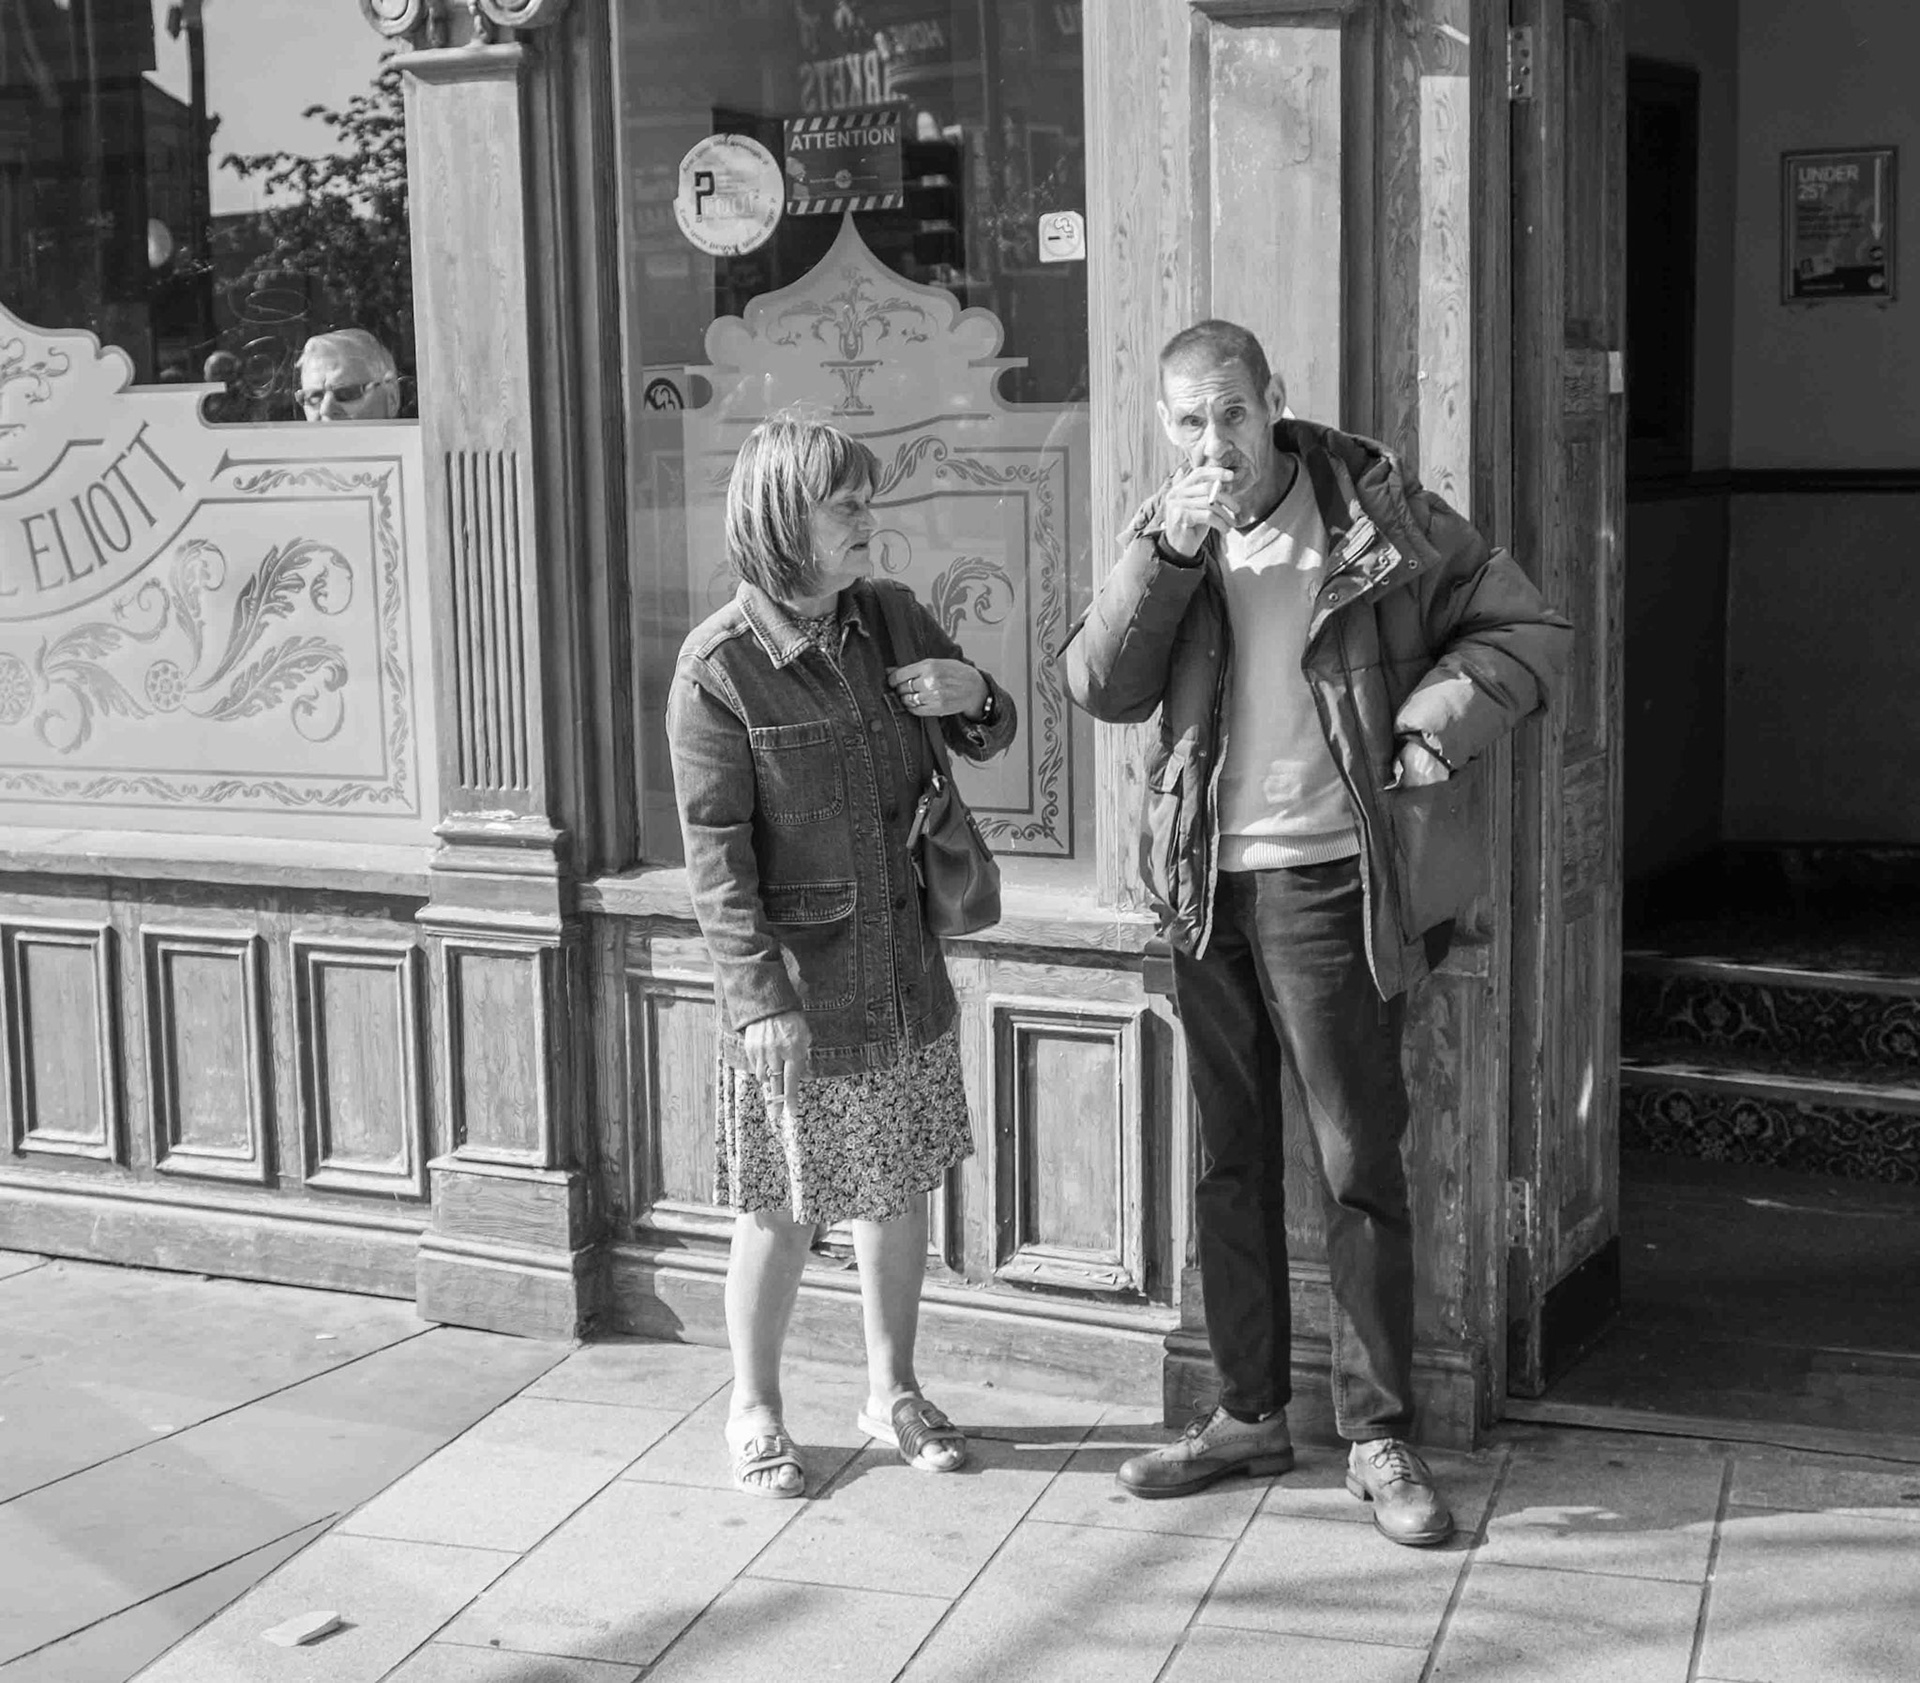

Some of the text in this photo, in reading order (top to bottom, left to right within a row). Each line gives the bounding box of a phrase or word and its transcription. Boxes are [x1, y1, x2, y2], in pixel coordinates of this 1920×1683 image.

[790, 128, 896, 150] ATTENTION
[1798, 164, 1859, 183] UNDER
[20, 421, 185, 593] ELIOTT
